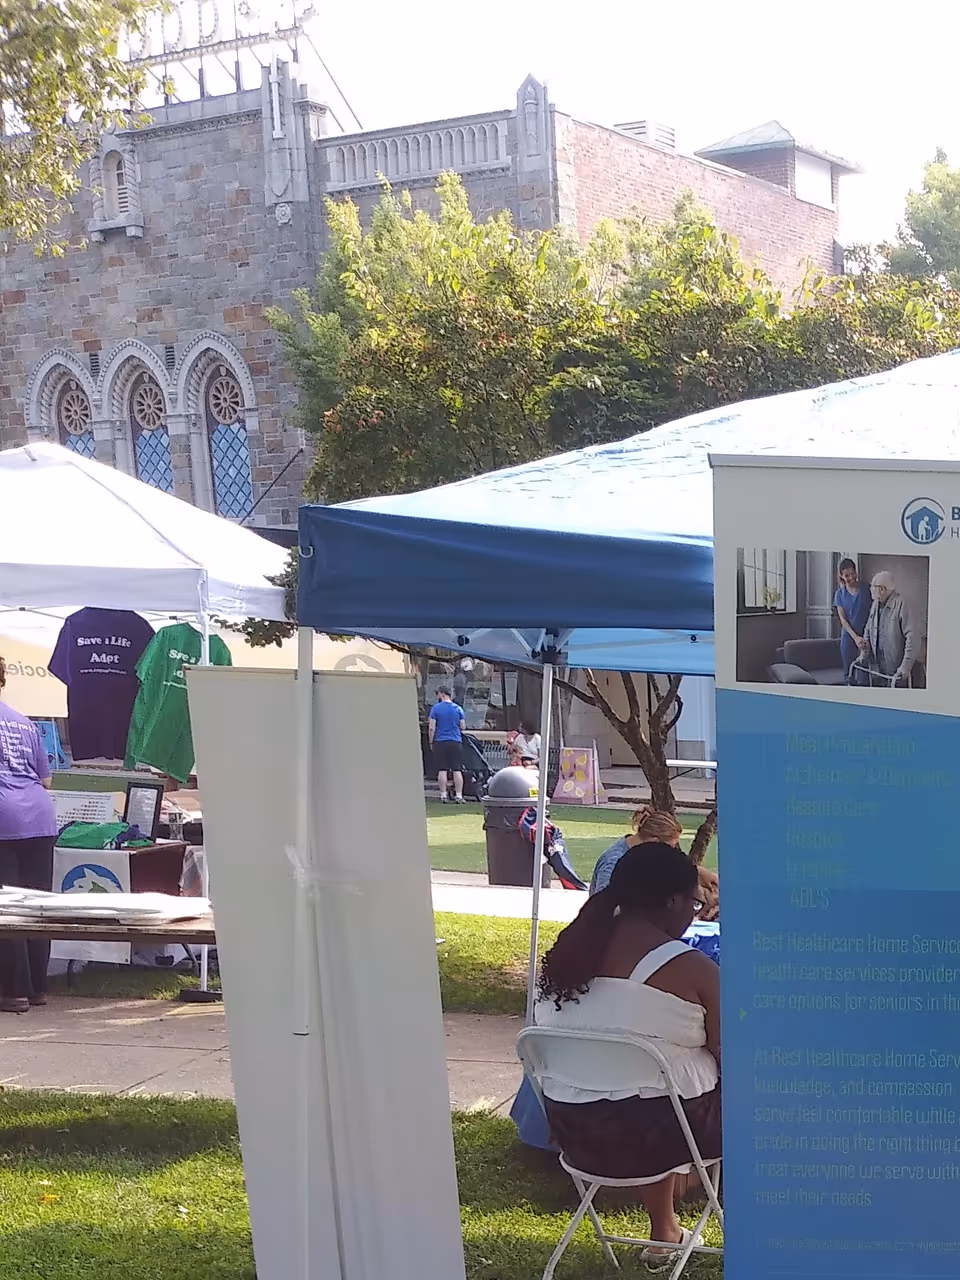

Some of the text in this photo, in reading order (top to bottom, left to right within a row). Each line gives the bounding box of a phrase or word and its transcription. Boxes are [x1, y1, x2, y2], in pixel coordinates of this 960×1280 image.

[77, 636, 102, 647] Save
[110, 635, 131, 647] Life
[868, 933, 908, 954] Home
[835, 962, 895, 982] services
[900, 962, 960, 986] provider
[927, 993, 939, 1011] in
[885, 1048, 925, 1067] Home
[839, 1078, 864, 1096] and
[916, 1106, 955, 1124] while
[795, 1134, 808, 1150] in
[853, 1133, 875, 1151] the
[879, 1135, 912, 1154] right
[916, 1134, 951, 1154] thing
[859, 1164, 881, 1179] we
[884, 1164, 923, 1180] serve
[926, 1162, 960, 1180] with
